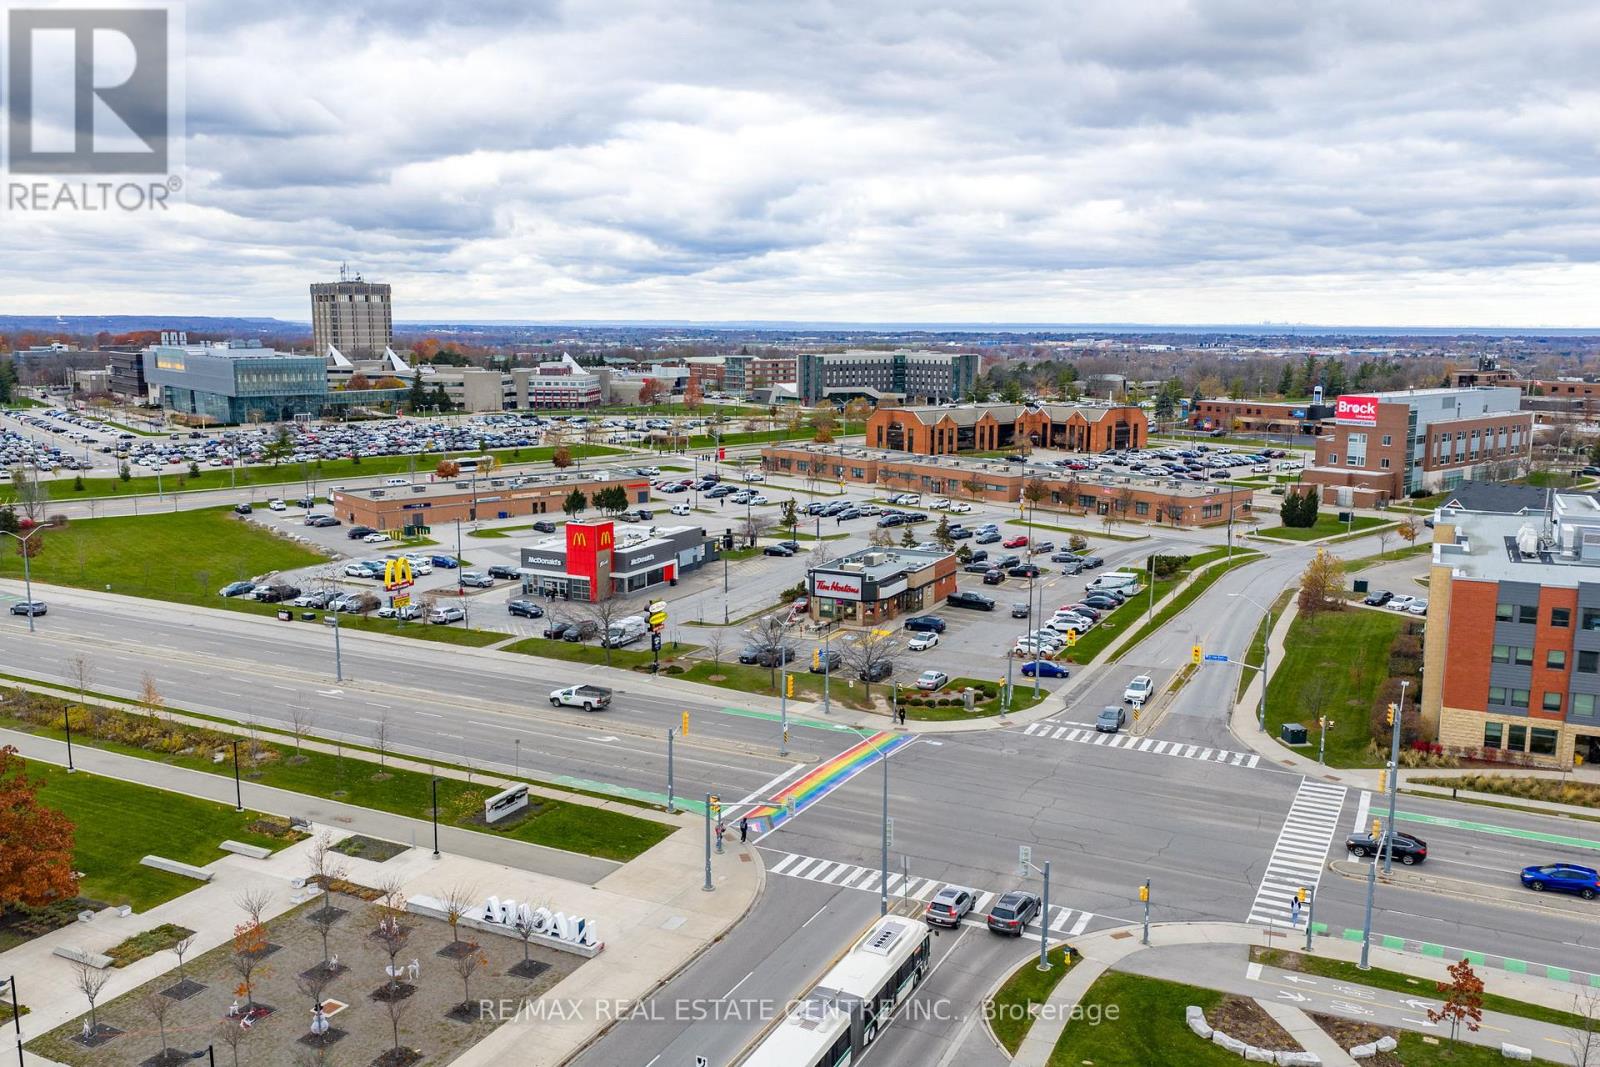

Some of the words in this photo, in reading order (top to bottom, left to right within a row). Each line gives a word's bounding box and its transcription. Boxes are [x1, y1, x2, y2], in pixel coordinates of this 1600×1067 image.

[1338, 401, 1376, 414] Brock
[528, 556, 562, 566] McDonald's
[816, 580, 830, 591] Tim
[830, 581, 859, 594] Hortons
